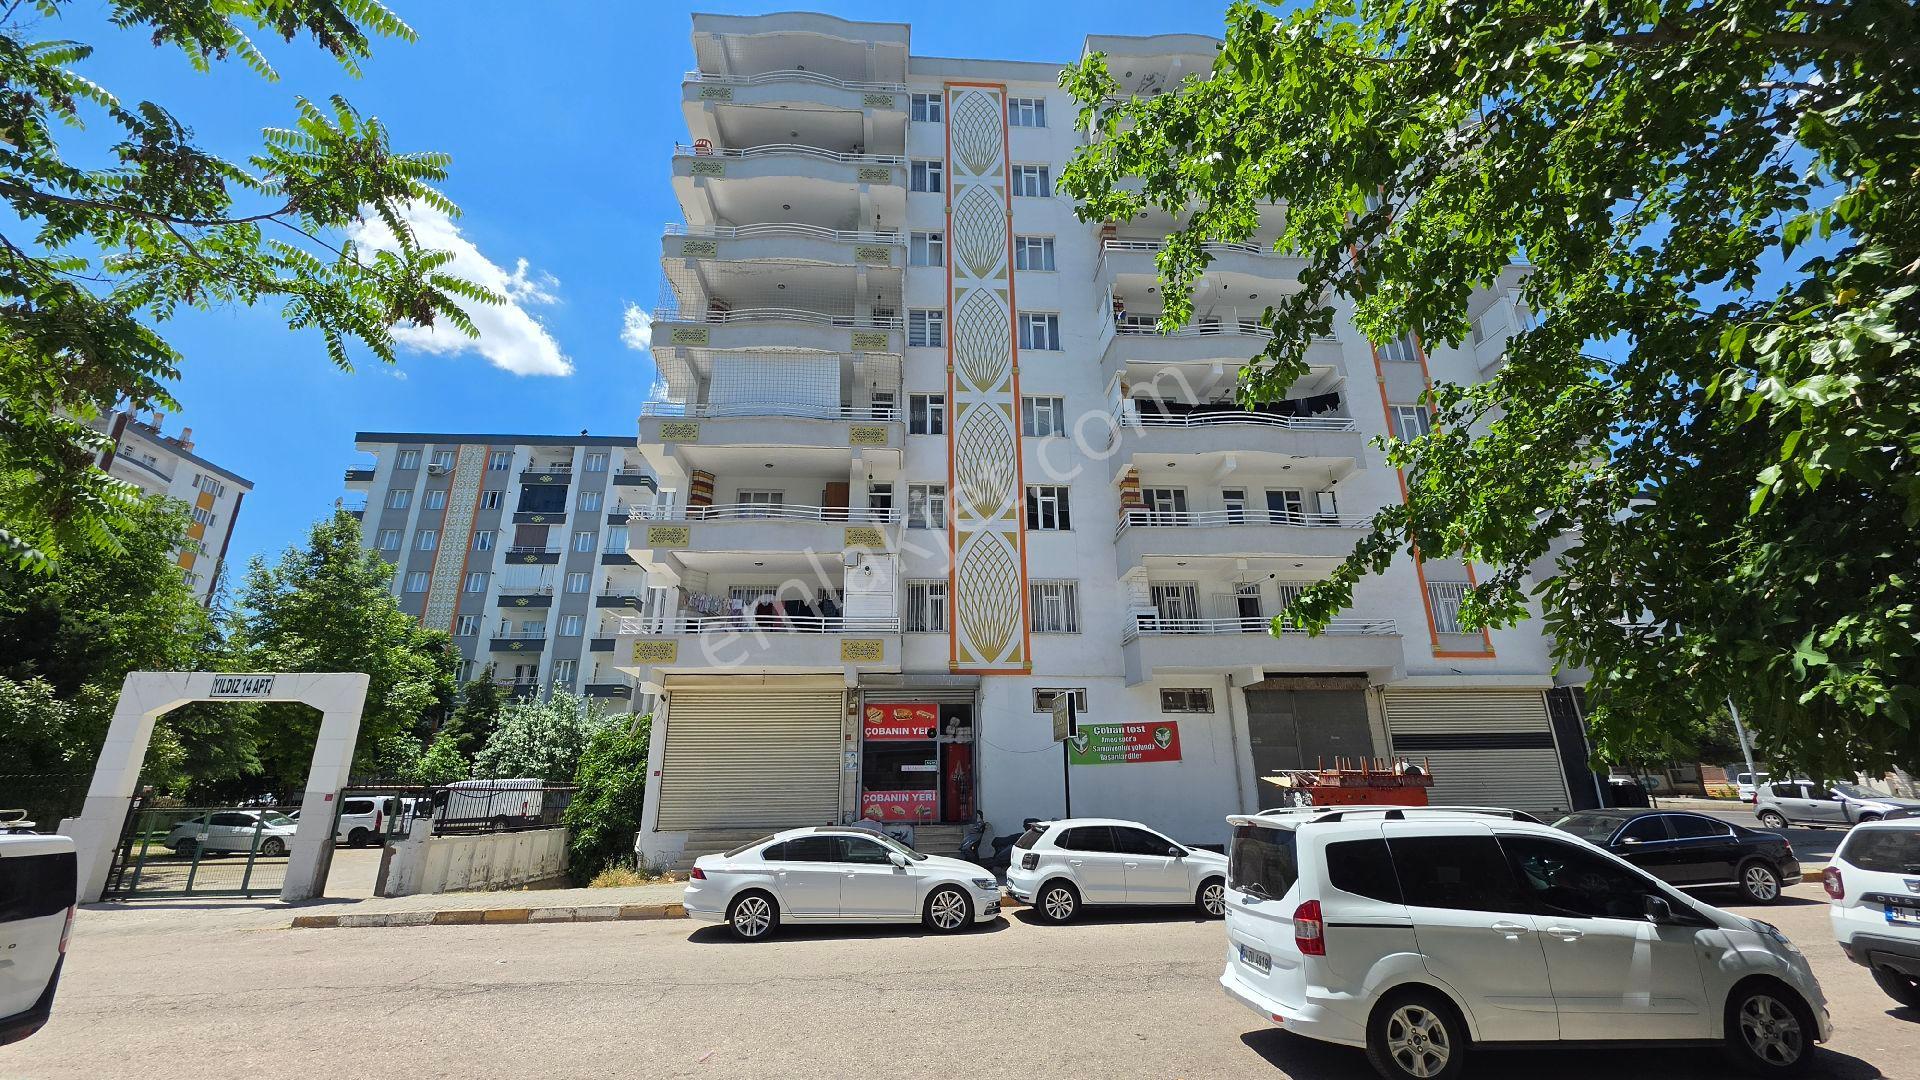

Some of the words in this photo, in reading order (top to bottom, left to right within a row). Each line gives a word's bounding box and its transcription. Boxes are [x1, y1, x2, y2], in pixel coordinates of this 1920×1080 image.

[214, 678, 241, 693] YILDIZ
[242, 679, 253, 693] 14
[864, 727, 910, 737] ÇOBANIN
[912, 725, 936, 735] YE
[863, 793, 909, 803] ÇOBANIN
[912, 791, 936, 801] YERİ
